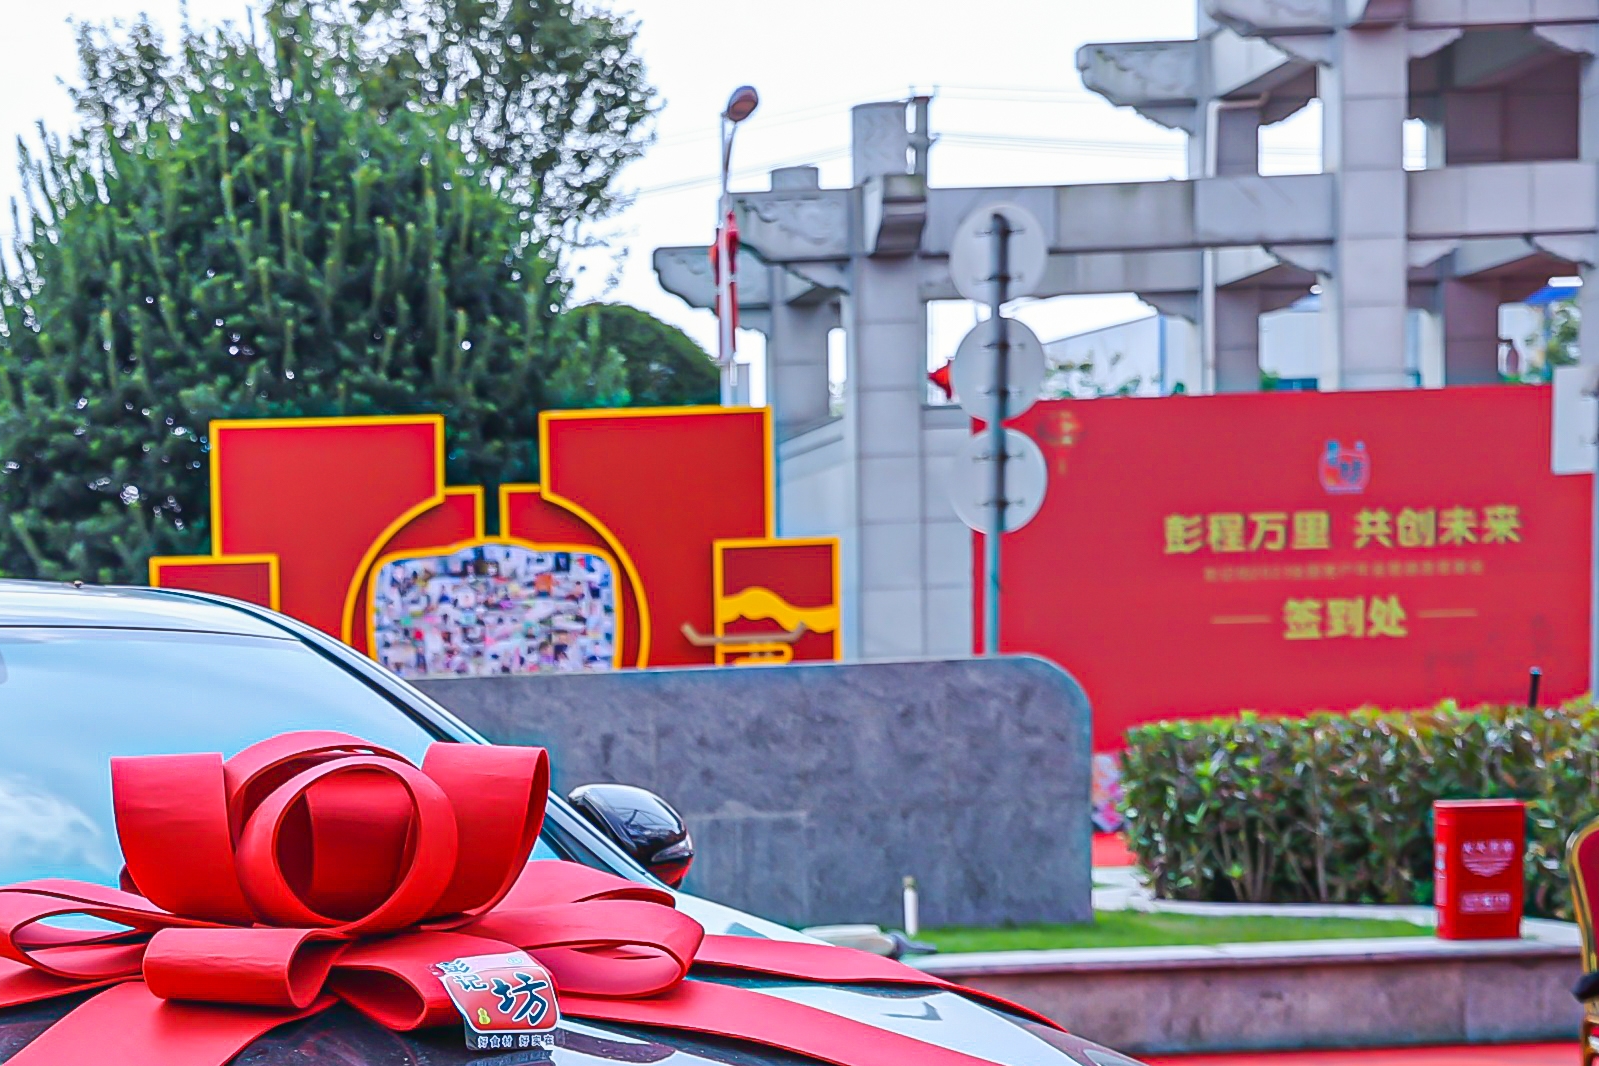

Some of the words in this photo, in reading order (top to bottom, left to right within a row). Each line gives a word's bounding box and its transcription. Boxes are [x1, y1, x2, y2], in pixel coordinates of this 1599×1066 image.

[1164, 511, 1331, 554] 彭程万里
[1354, 505, 1522, 549] 共创未来
[1283, 594, 1408, 640] 签到处
